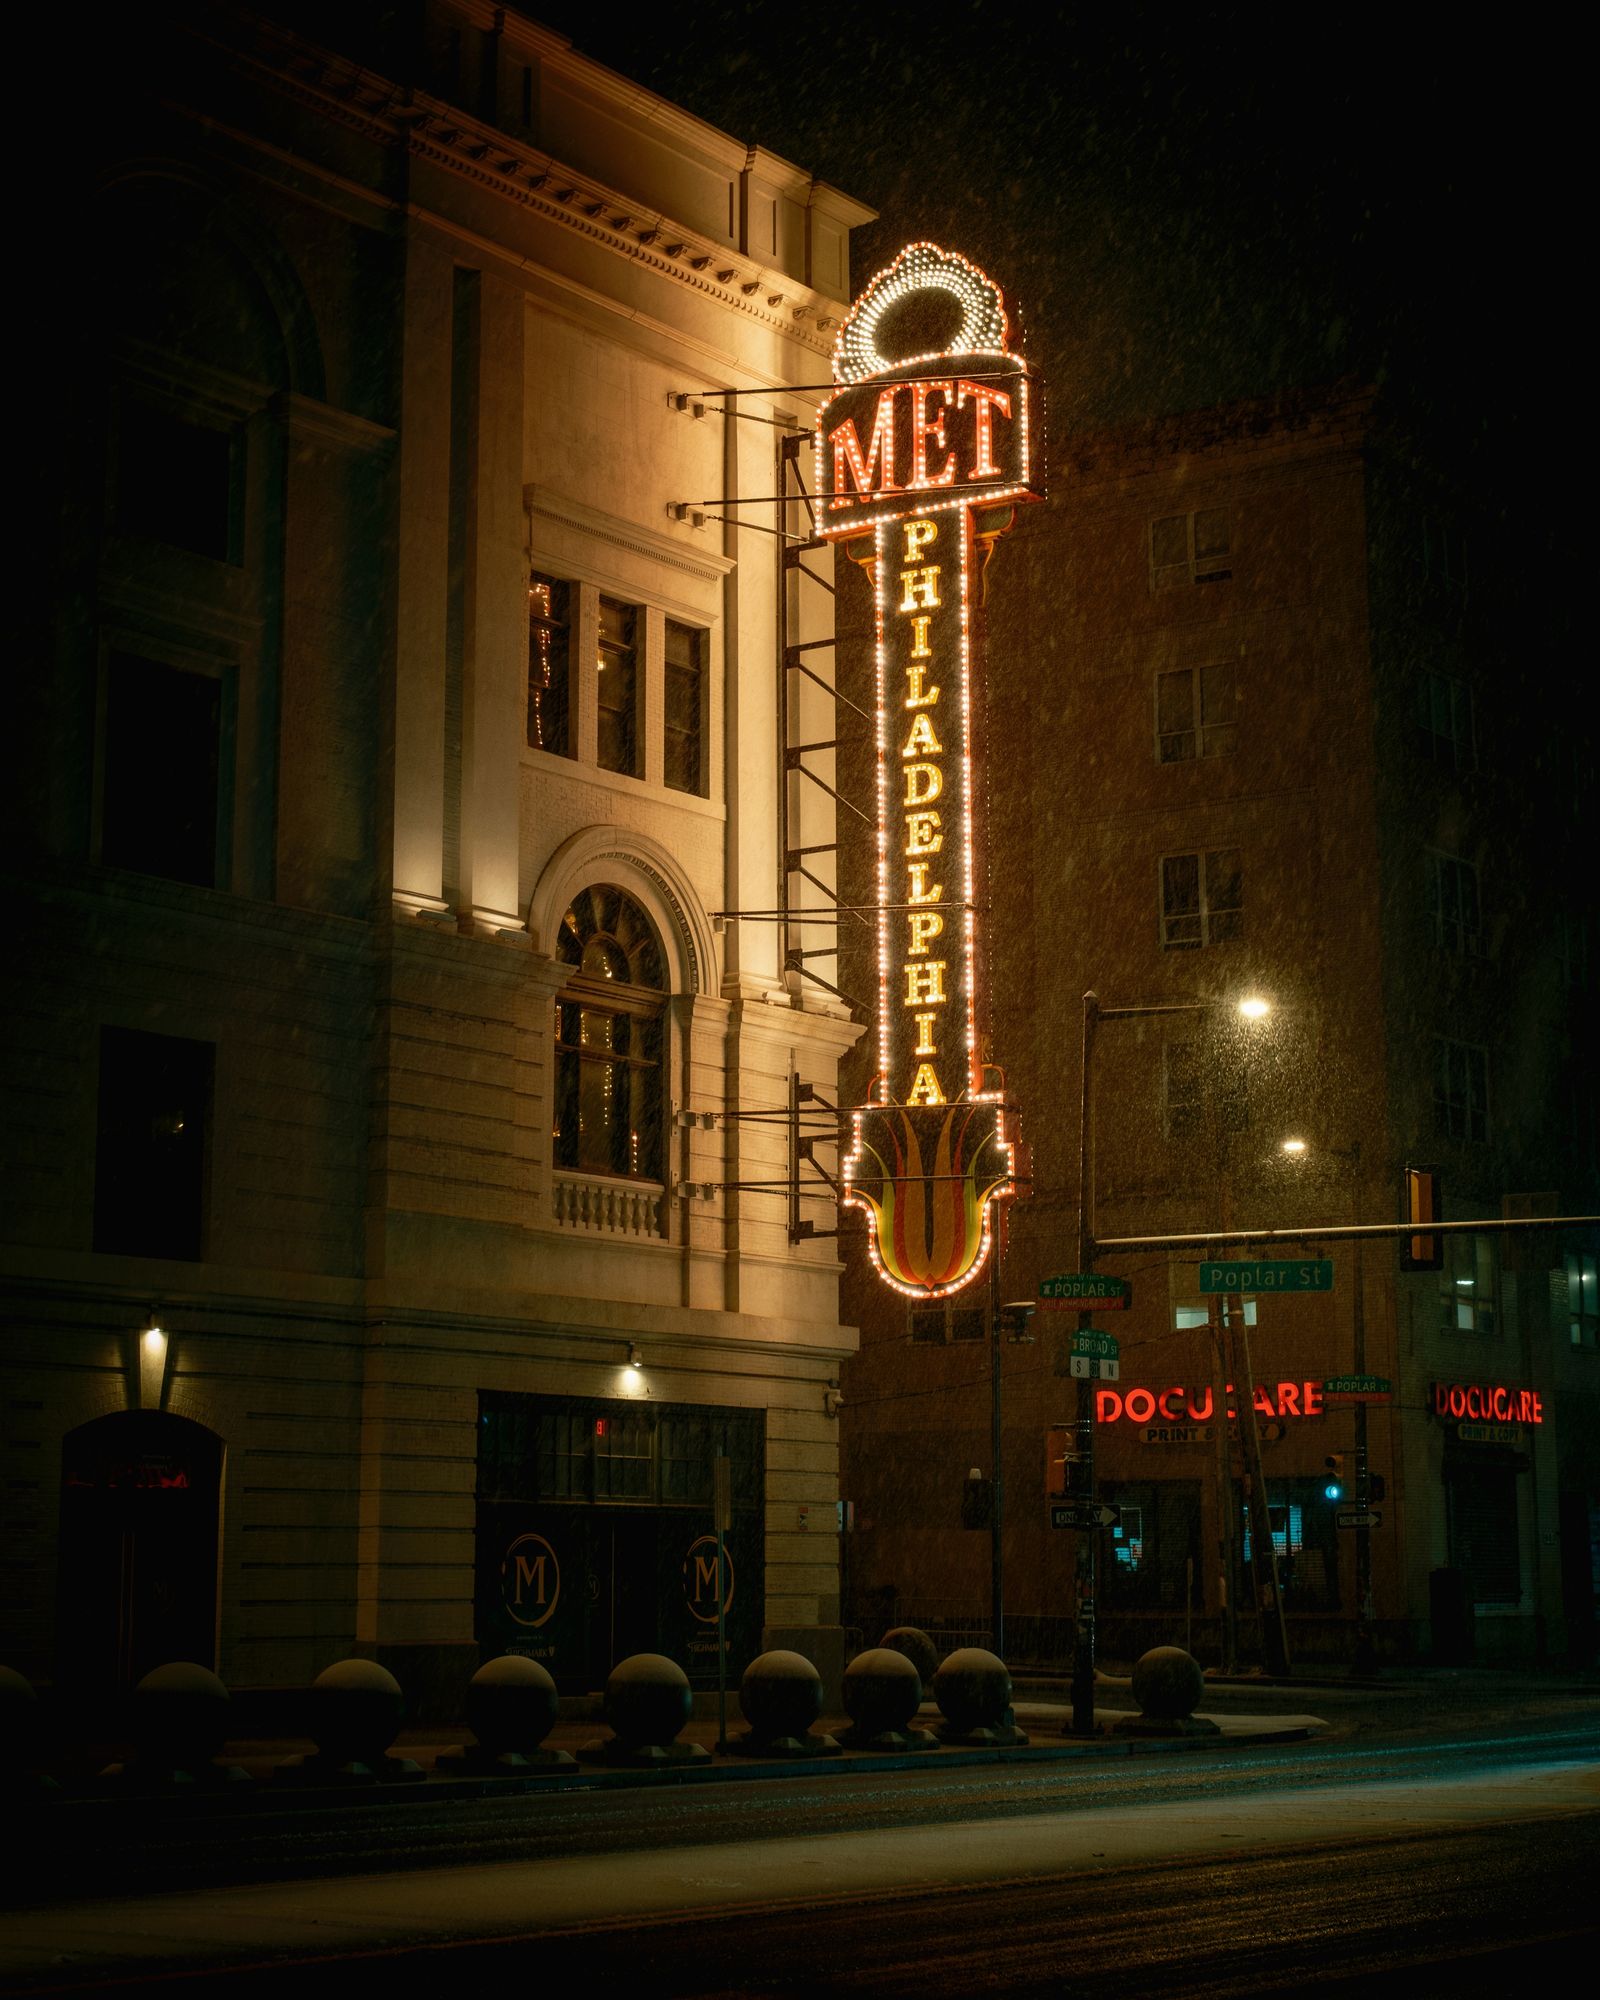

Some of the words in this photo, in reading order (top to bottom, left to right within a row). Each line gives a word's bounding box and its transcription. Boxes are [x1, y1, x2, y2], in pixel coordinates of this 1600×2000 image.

[829, 380, 1011, 509] MET
[900, 521, 946, 1106] PHILADELPHIA
[1210, 1266, 1287, 1291] Poplar
[1300, 1265, 1321, 1285] St
[1055, 1283, 1105, 1297] POPLAR
[1110, 1286, 1121, 1297] ST
[1079, 1338, 1108, 1354] BROAD
[1110, 1345, 1117, 1355] ST
[1076, 1360, 1081, 1374] S
[1108, 1363, 1114, 1376] N
[1336, 1381, 1376, 1392] POPLAR
[1435, 1382, 1543, 1424] DOCUCARE
[1147, 1428, 1198, 1441] PRINT
[513, 1555, 547, 1605] M
[692, 1556, 723, 1603] M
